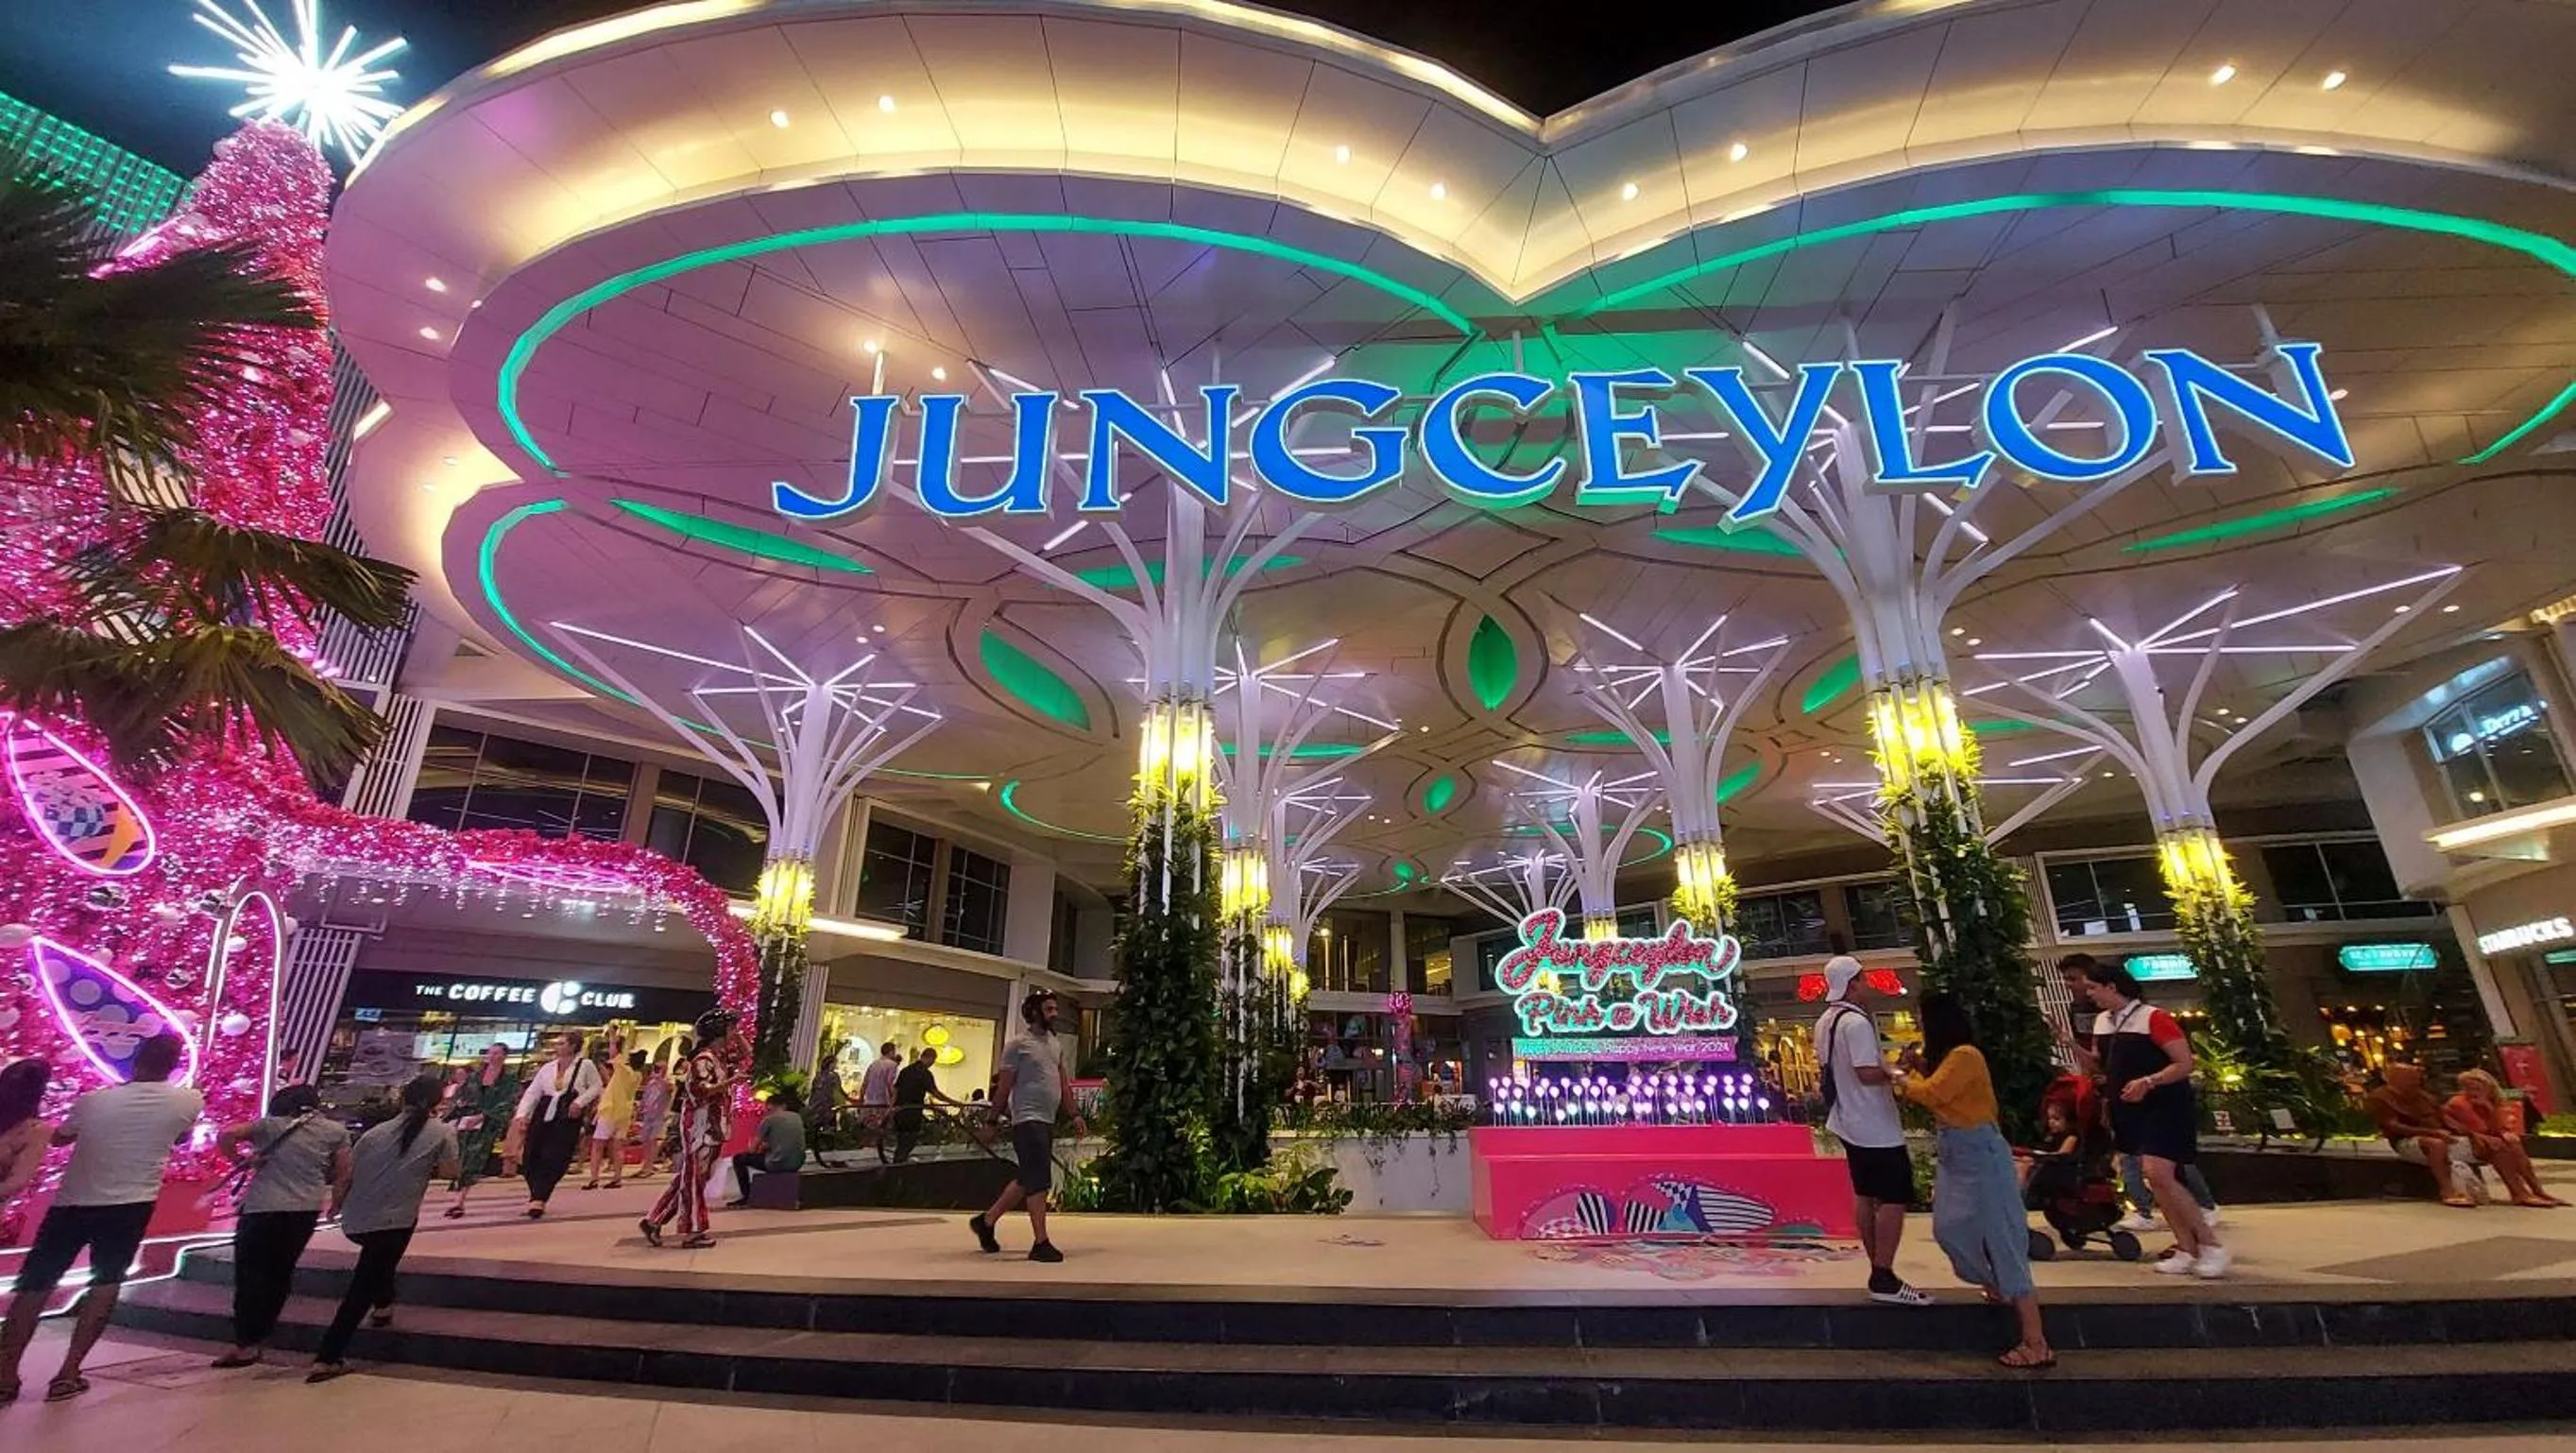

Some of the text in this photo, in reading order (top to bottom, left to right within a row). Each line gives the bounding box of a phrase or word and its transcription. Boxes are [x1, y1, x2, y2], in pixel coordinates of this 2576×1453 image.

[771, 341, 2358, 529] JUNGCEYLON
[1498, 907, 1738, 992] Jungceylon
[416, 983, 636, 1009] THE COFFEE CLUB
[1609, 1003, 1639, 1029] a
[1636, 990, 1736, 1033] Wish
[1700, 1041, 1731, 1052] 2024
